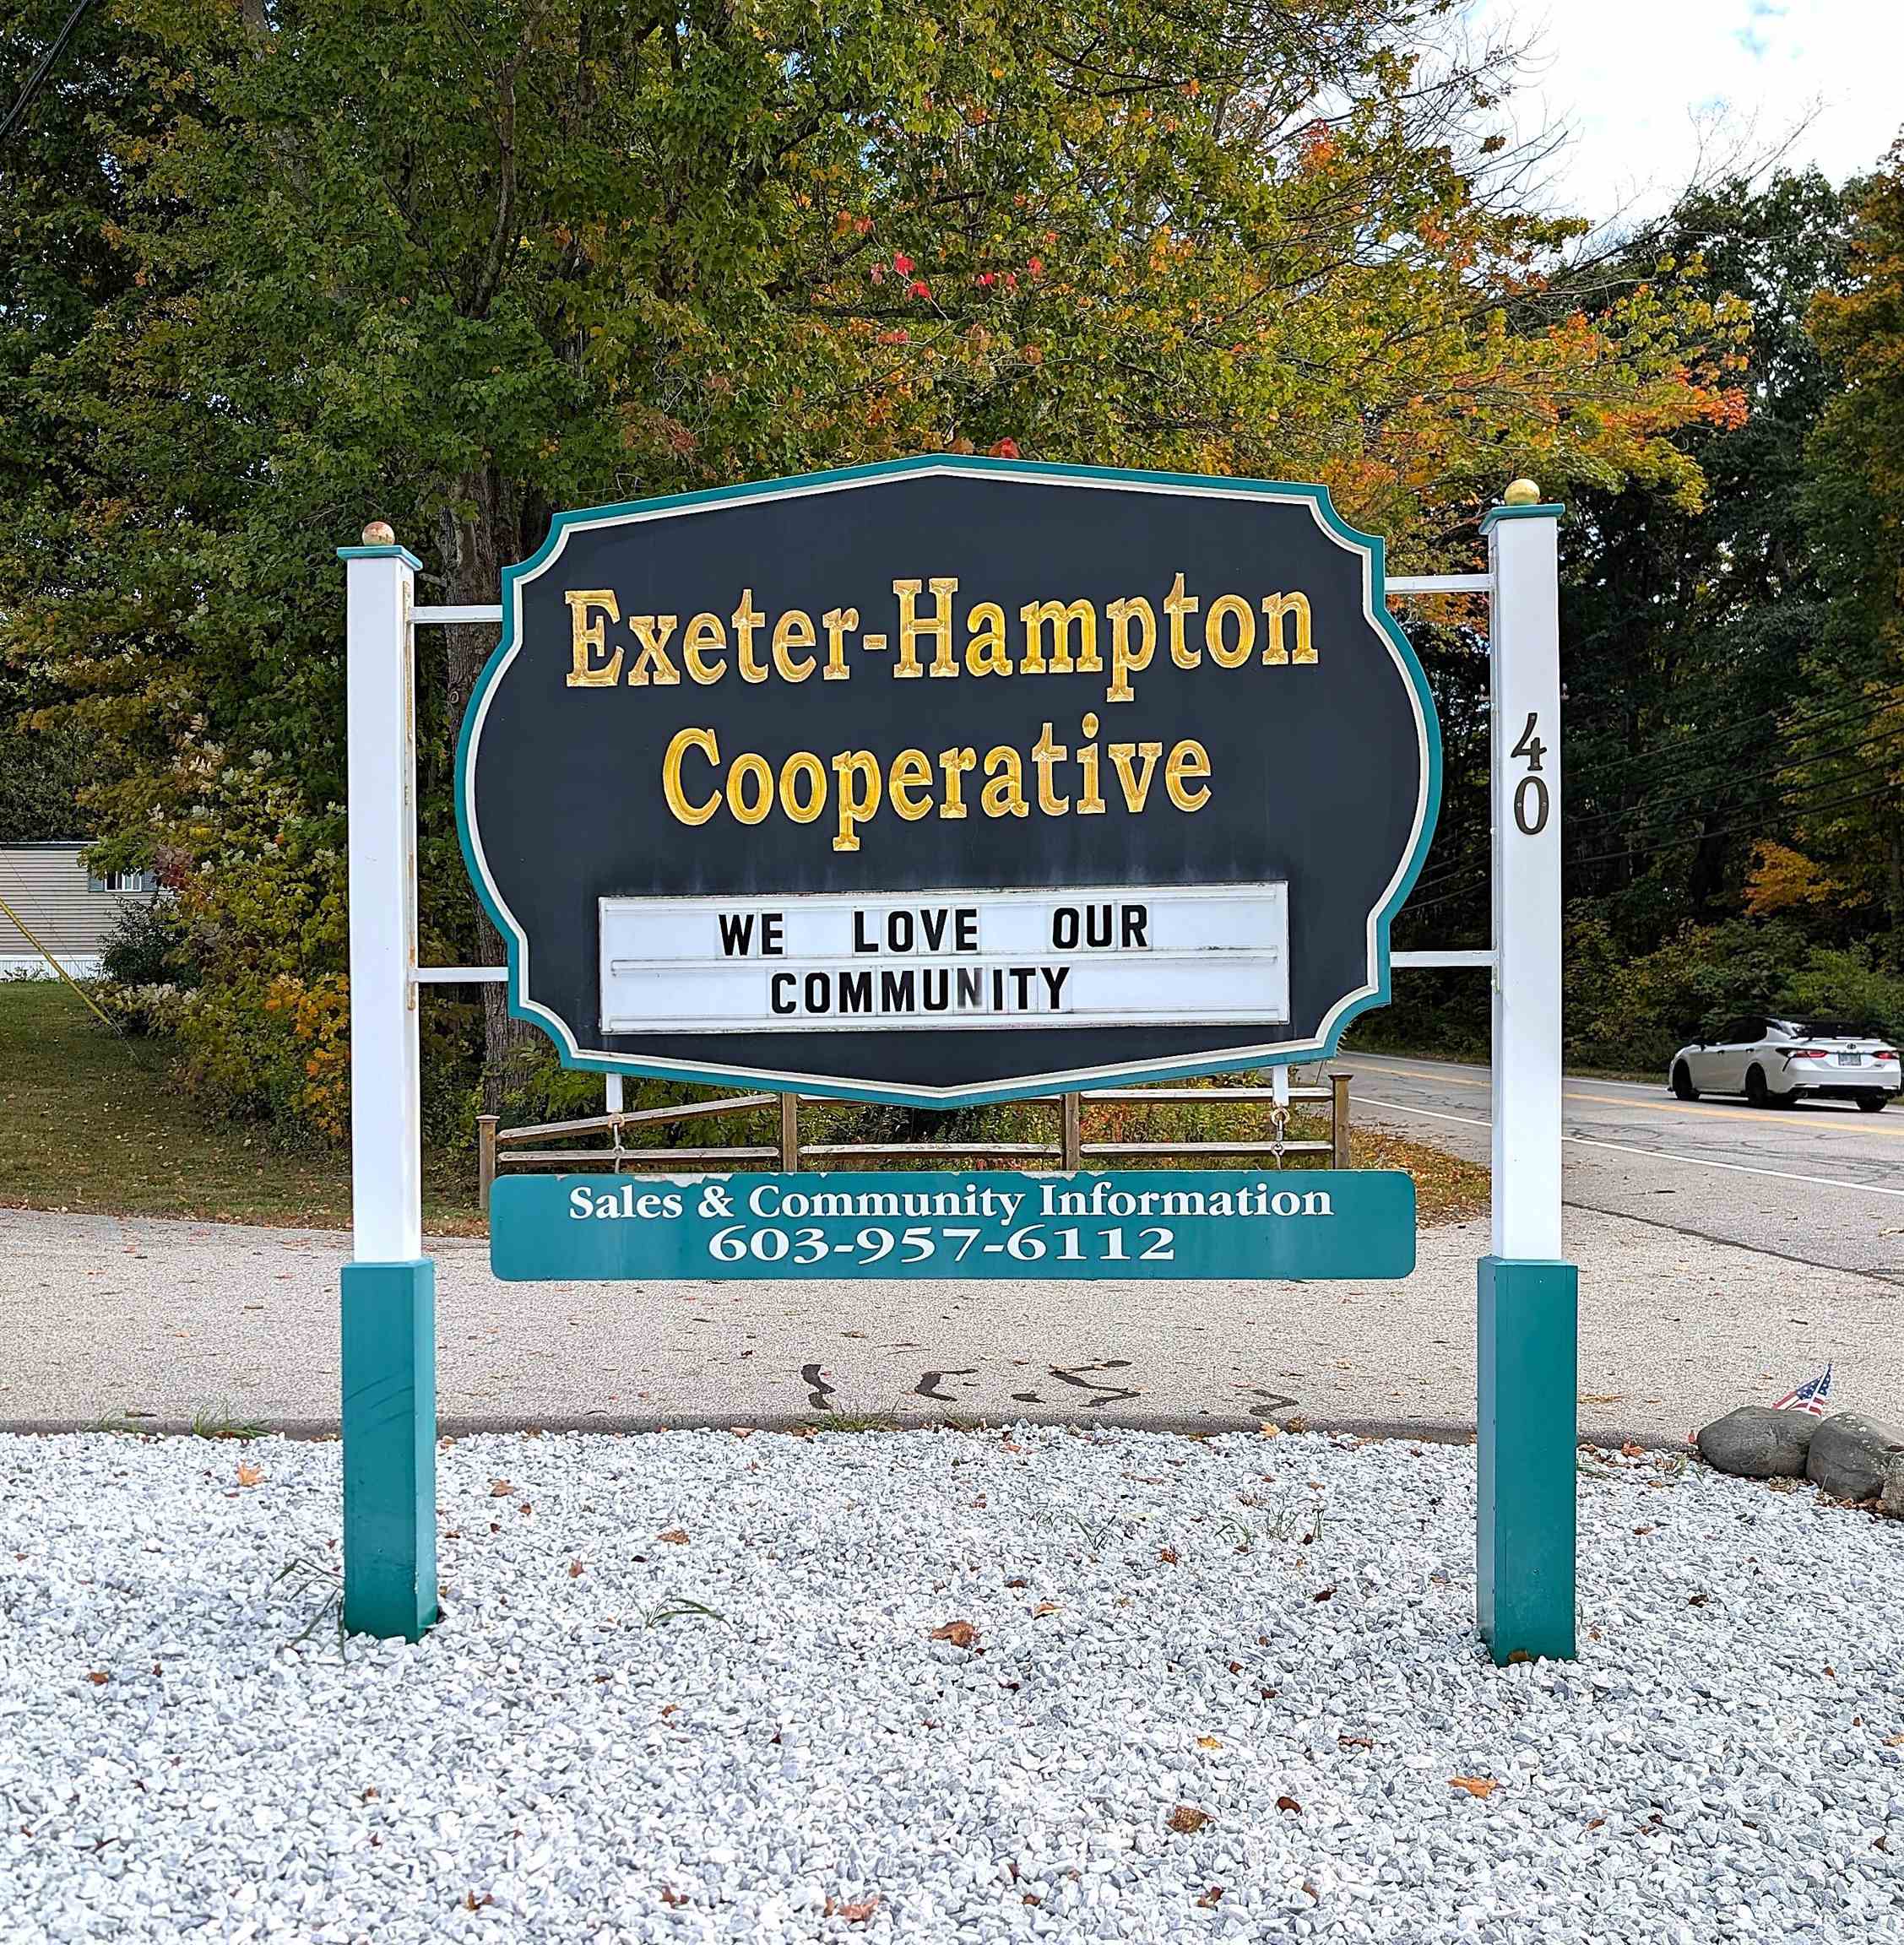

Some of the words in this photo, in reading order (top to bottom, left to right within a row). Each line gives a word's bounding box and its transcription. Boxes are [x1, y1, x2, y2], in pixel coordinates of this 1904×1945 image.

[564, 572, 1319, 702] Exeter-Hampton
[662, 712, 1212, 852] Cooperative
[1511, 712, 1549, 835] 40
[719, 913, 784, 956] WE
[854, 908, 979, 953] LOVE
[1052, 904, 1148, 949] OUR
[770, 967, 1071, 1015] COMMUNITY
[568, 1184, 684, 1220] Sales
[697, 1185, 734, 1218] &
[748, 1184, 1026, 1226] Community
[1039, 1182, 1334, 1217] Information
[708, 1224, 1175, 1265] 603-957-6112
